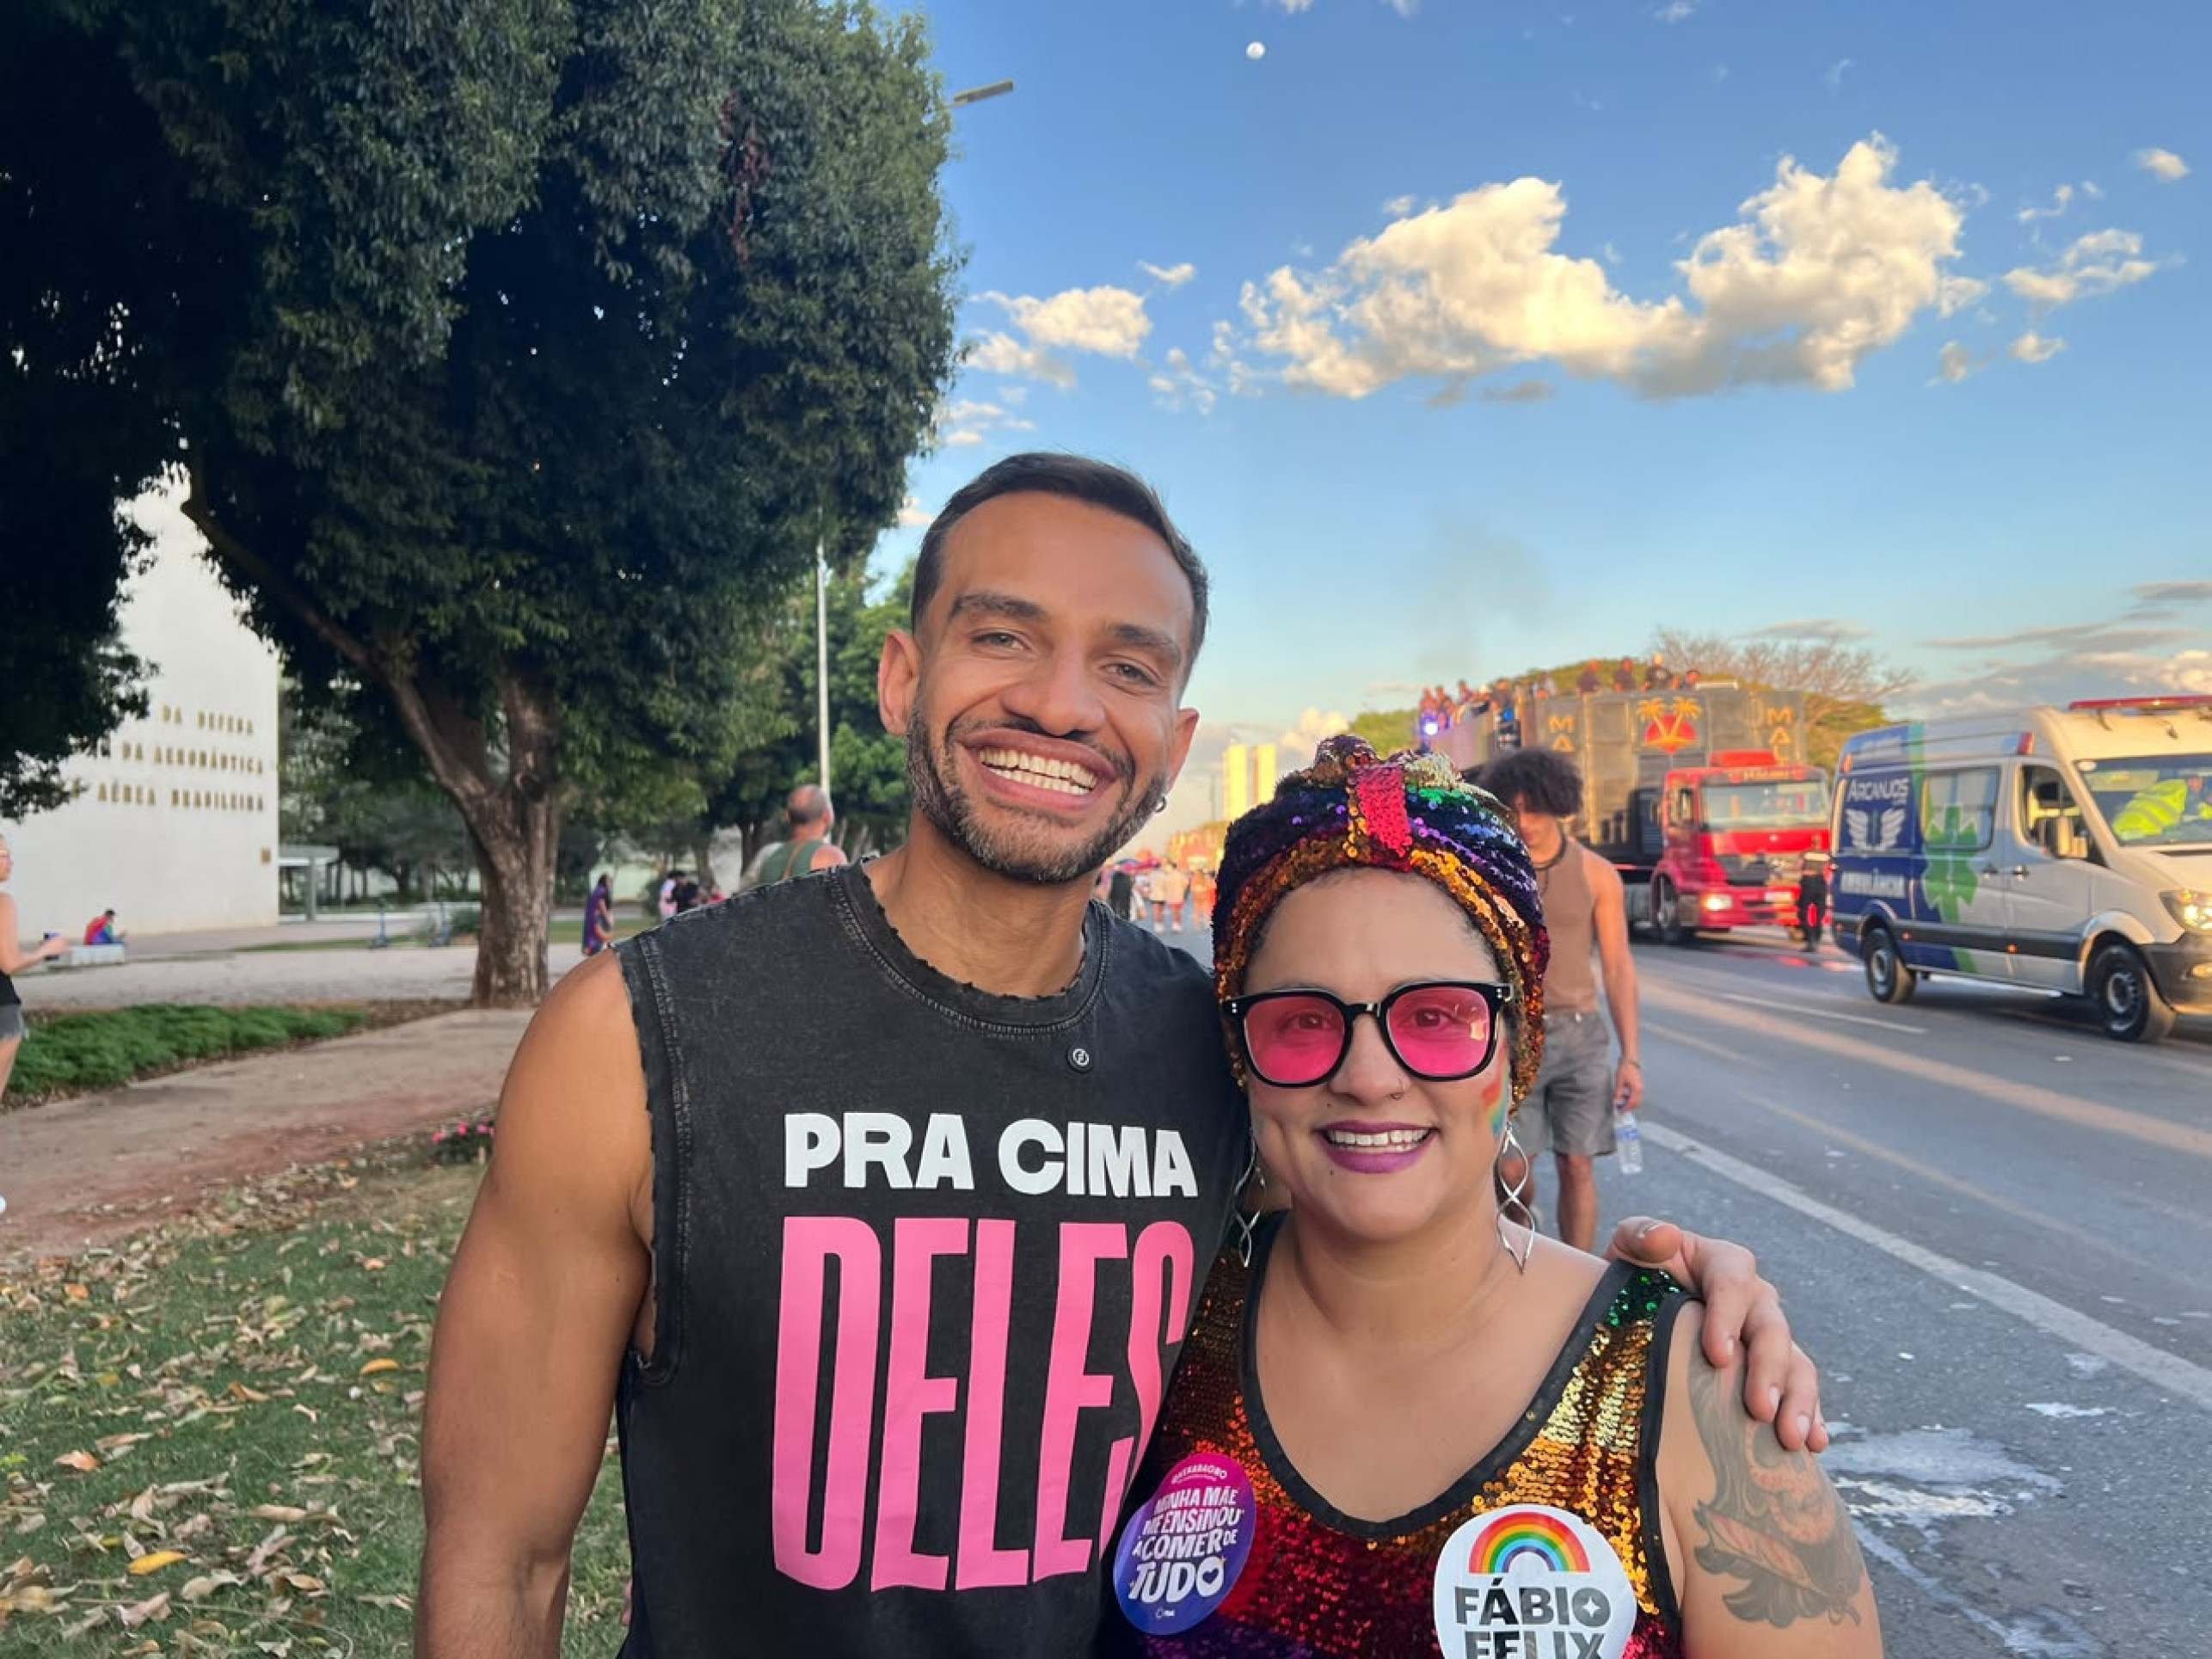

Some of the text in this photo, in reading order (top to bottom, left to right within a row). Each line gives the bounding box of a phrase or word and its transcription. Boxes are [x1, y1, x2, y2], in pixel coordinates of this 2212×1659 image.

[163, 704, 253, 734] DA DEFESA
[123, 742, 143, 761] DA
[172, 789, 263, 811] BRASILEIRA
[784, 1113, 1199, 1197] PRA CIMA
[1141, 1528, 1223, 1561] COMER
[1223, 1529, 1238, 1545] DE
[1128, 1556, 1224, 1603] TUDO
[1454, 1577, 1611, 1628] FÁBIO
